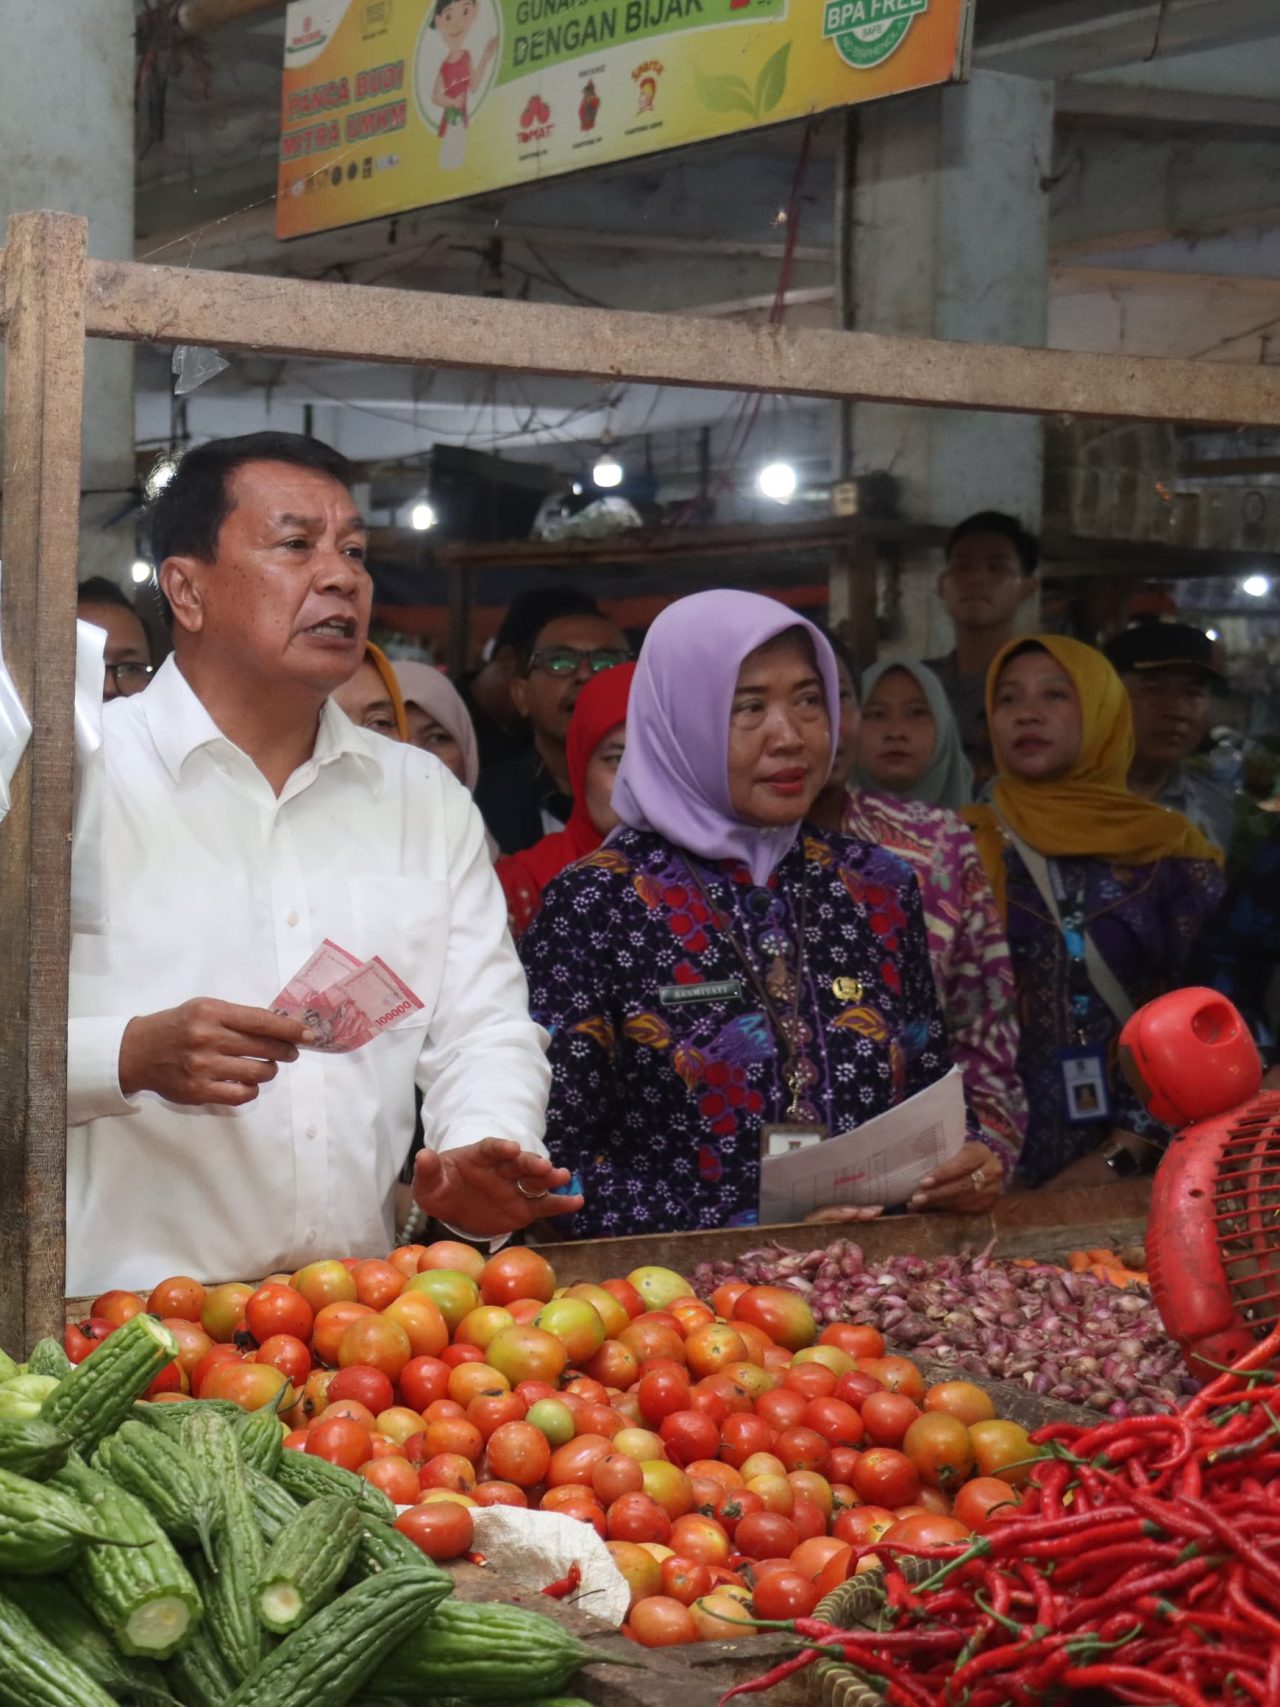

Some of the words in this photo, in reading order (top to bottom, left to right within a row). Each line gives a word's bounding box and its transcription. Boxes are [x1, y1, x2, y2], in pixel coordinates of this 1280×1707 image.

[827, 0, 865, 30] BPA
[513, 7, 617, 67] DENGAN
[863, 25, 883, 37] SAFE
[517, 124, 554, 144] TOMAT
[375, 1000, 412, 1027] 100000
